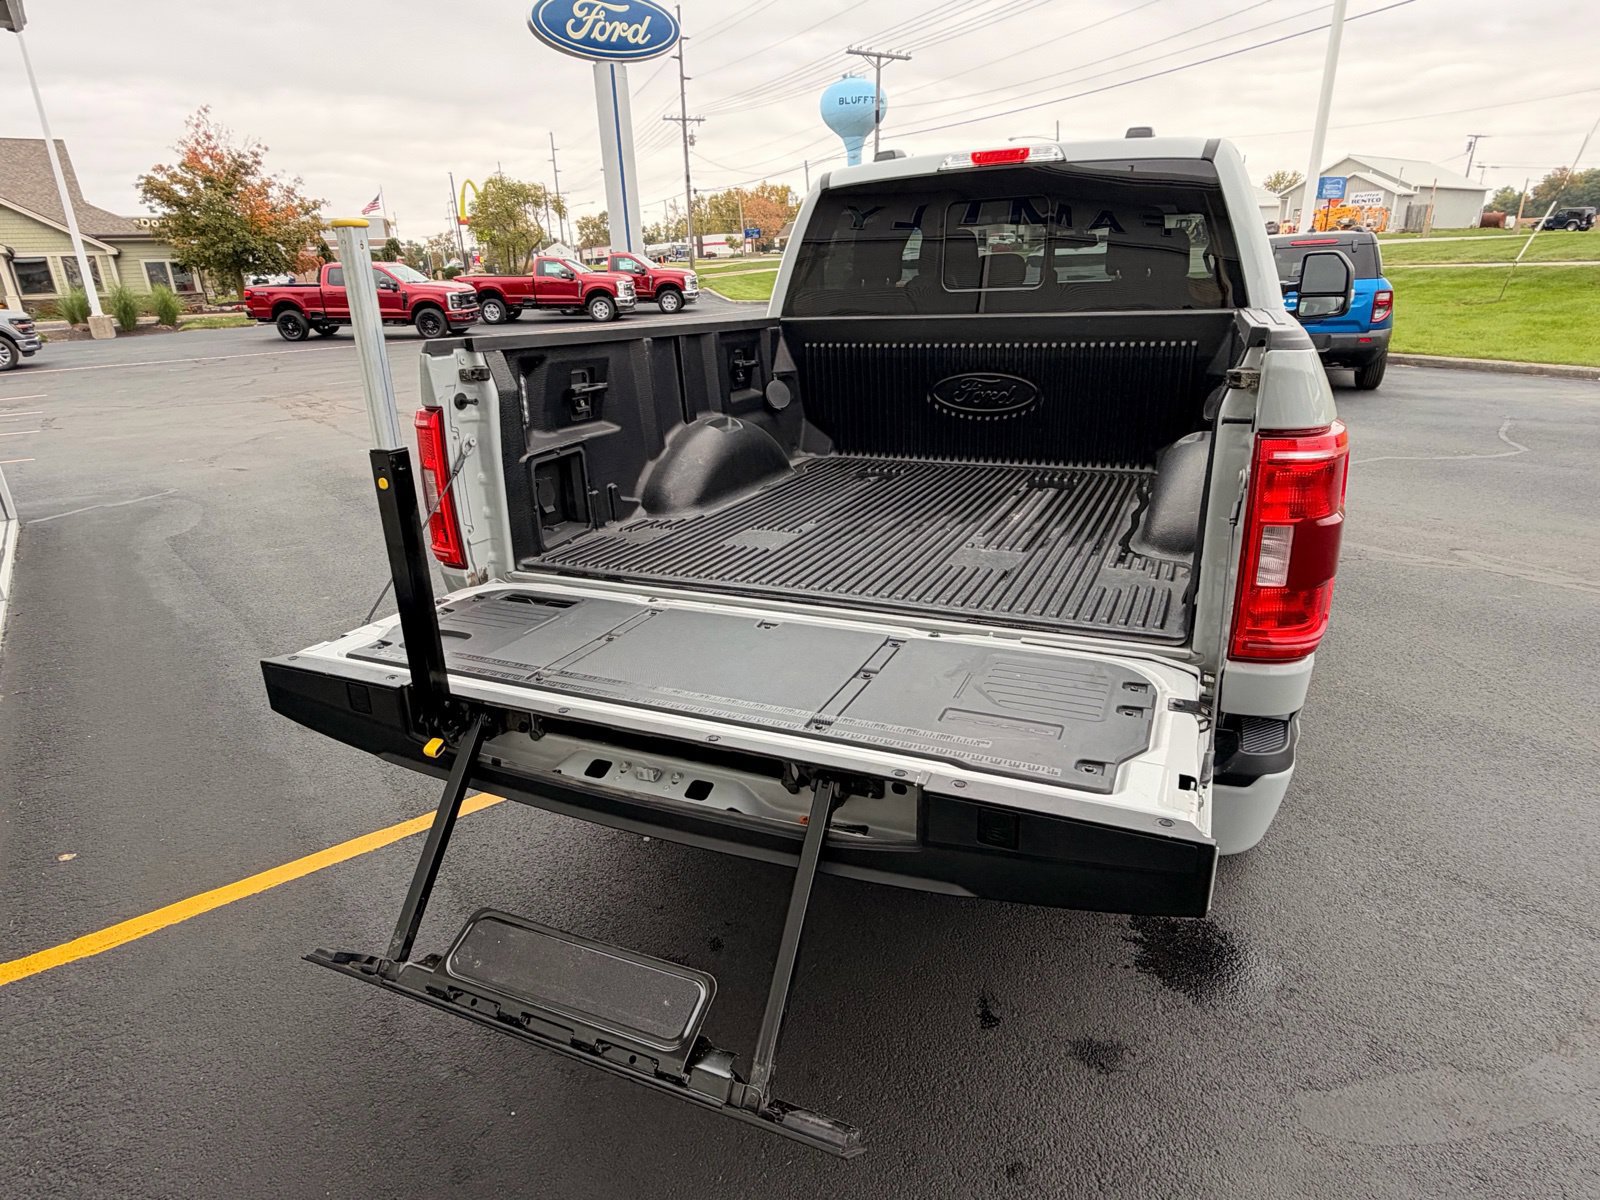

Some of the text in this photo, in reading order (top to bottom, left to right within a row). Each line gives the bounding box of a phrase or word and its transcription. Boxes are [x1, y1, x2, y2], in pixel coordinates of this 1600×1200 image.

[566, 0, 651, 45] Ford
[838, 96, 885, 105] BLUFFTN
[953, 377, 1017, 404] Ford
